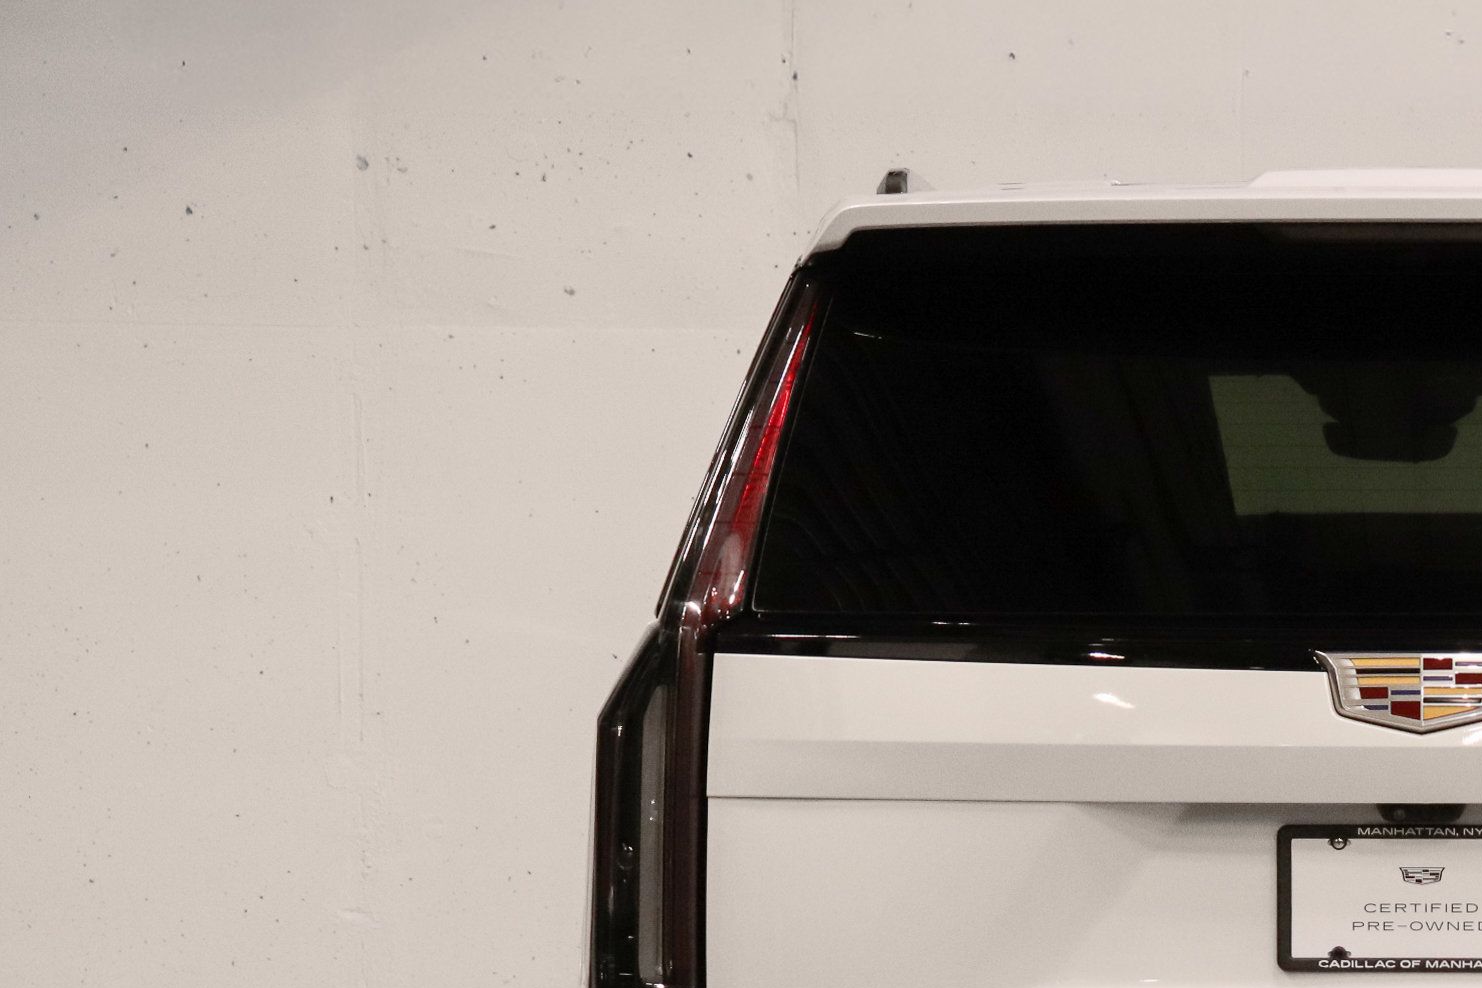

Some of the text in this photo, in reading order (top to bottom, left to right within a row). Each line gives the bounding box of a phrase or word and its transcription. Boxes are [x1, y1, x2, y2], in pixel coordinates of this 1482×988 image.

[1357, 826, 1459, 837] MANHATTAN,
[1363, 902, 1480, 914] CERTIFIED
[1318, 959, 1396, 969] CADILLAC
[1400, 959, 1420, 969] OF
